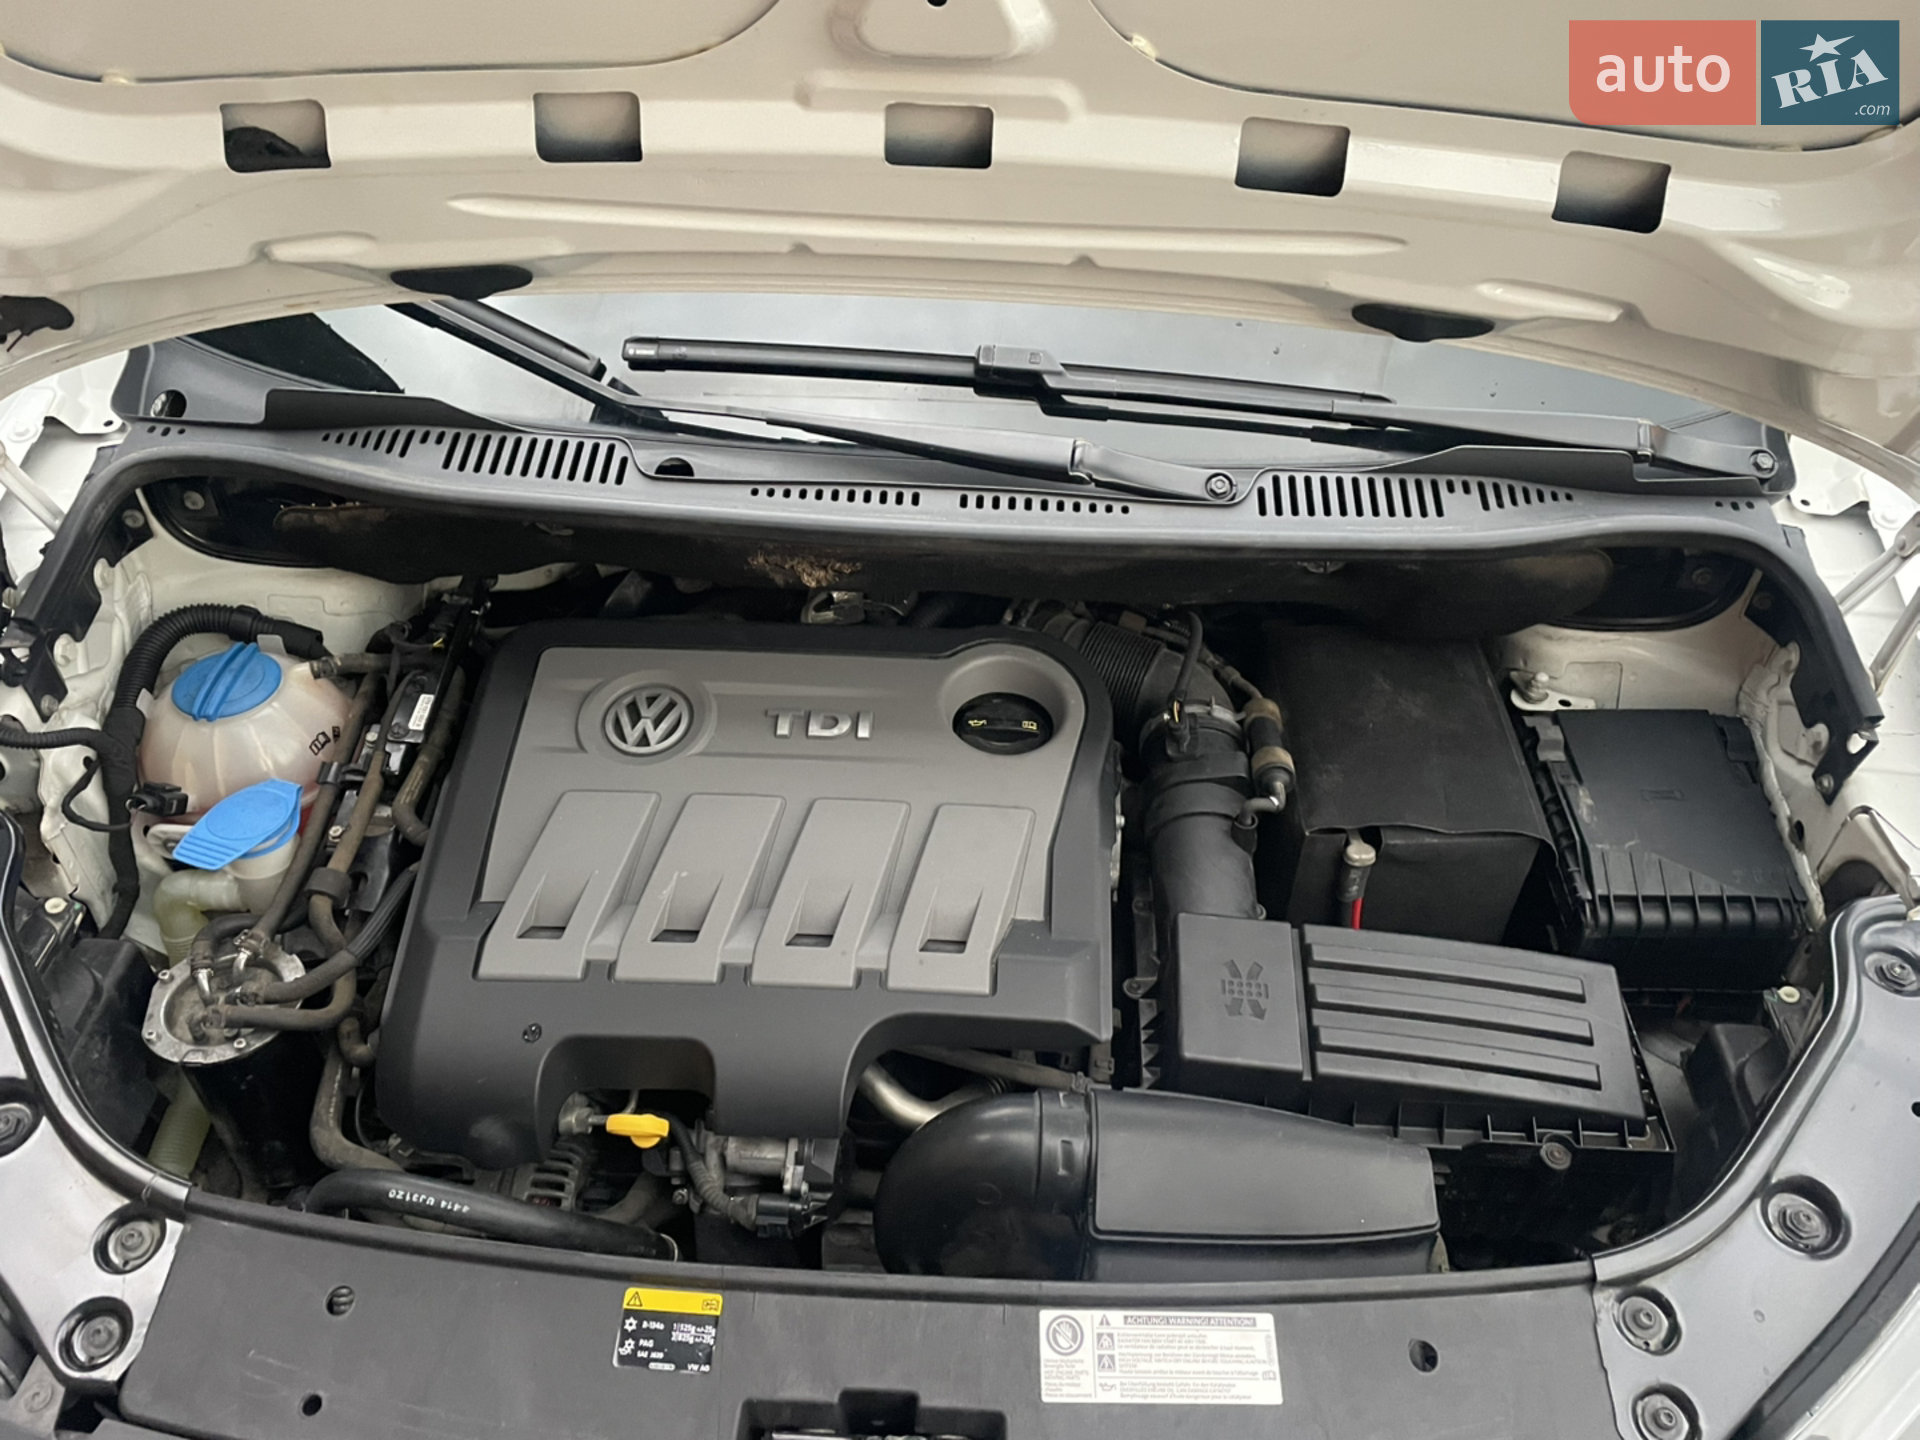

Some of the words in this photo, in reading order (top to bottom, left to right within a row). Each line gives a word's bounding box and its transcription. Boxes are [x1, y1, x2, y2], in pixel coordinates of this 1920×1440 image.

[765, 709, 873, 739] TDI
[1126, 1315, 1166, 1325] ACHTUNG!
[1168, 1316, 1208, 1326] WARNING!
[1210, 1317, 1254, 1327] ATTENTION!
